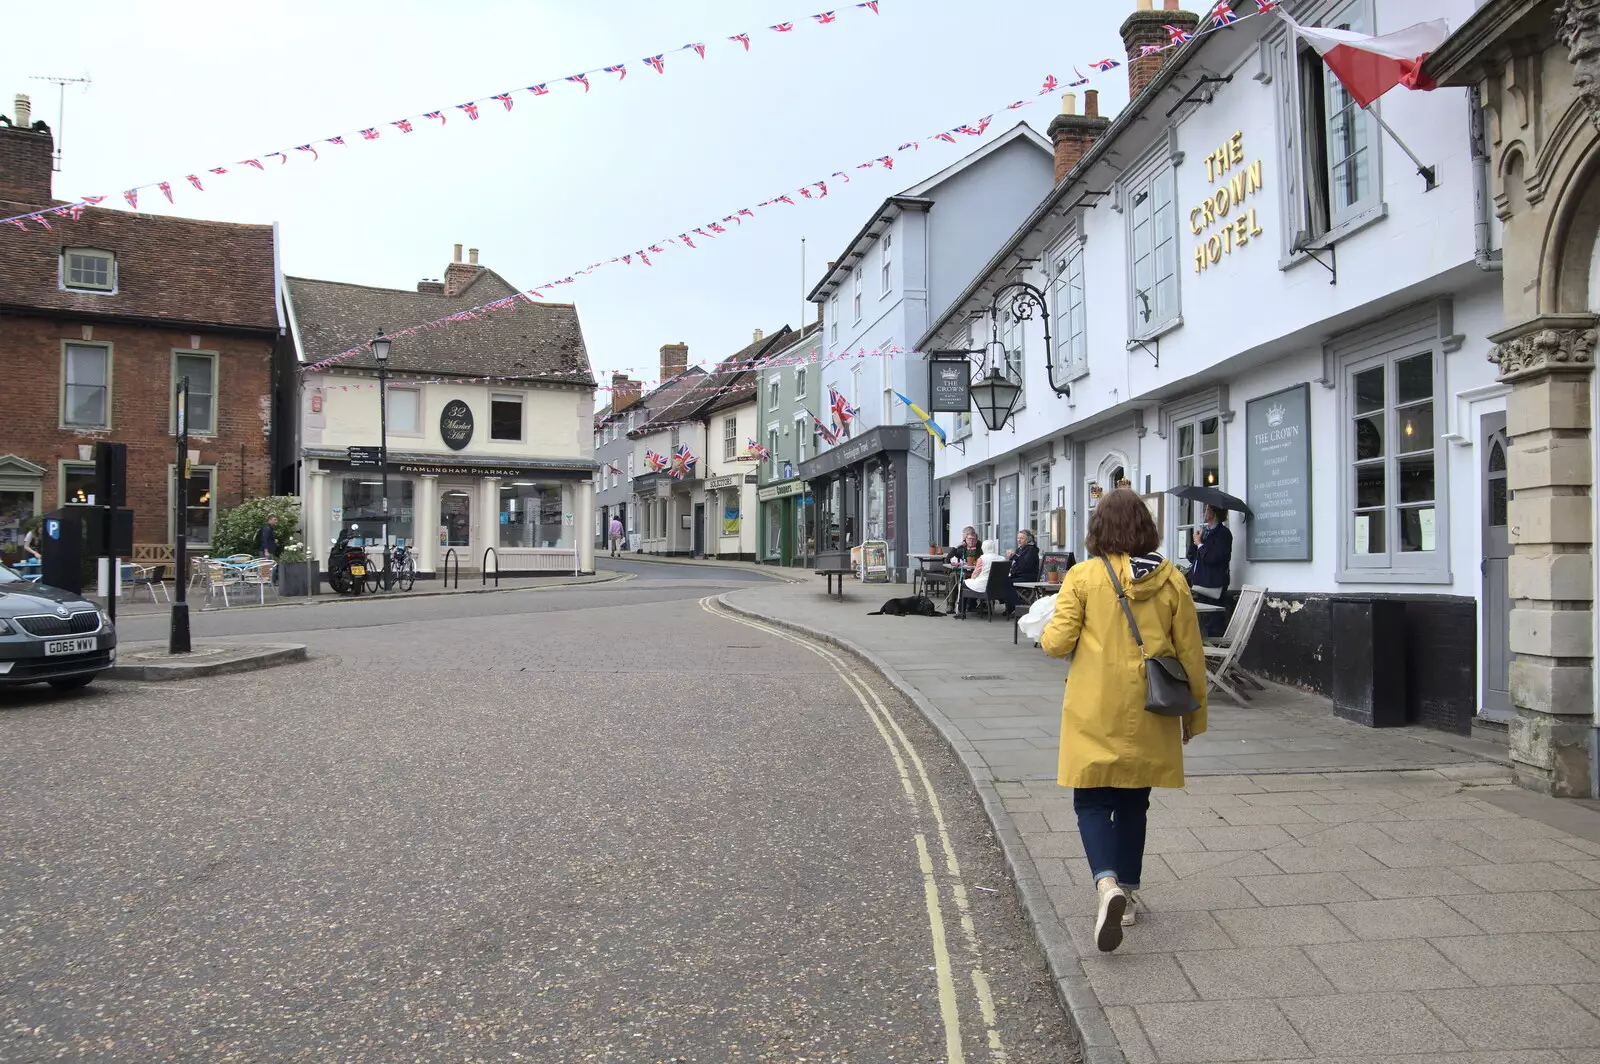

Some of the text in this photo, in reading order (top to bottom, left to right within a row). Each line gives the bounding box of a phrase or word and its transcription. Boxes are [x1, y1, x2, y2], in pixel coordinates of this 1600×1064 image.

[1204, 130, 1243, 183] THE
[1190, 159, 1262, 235] CROWN
[1194, 208, 1262, 274] HOTEL
[449, 406, 466, 417] 32
[442, 419, 471, 431] Market
[447, 431, 466, 440] Hill
[1255, 425, 1299, 445] THE CROWN
[400, 465, 520, 476] FRAMLINGHAM PHARMACY
[709, 477, 732, 488] SOLICITORS
[49, 522, 59, 536] P
[49, 639, 93, 654] GD65 WWV
